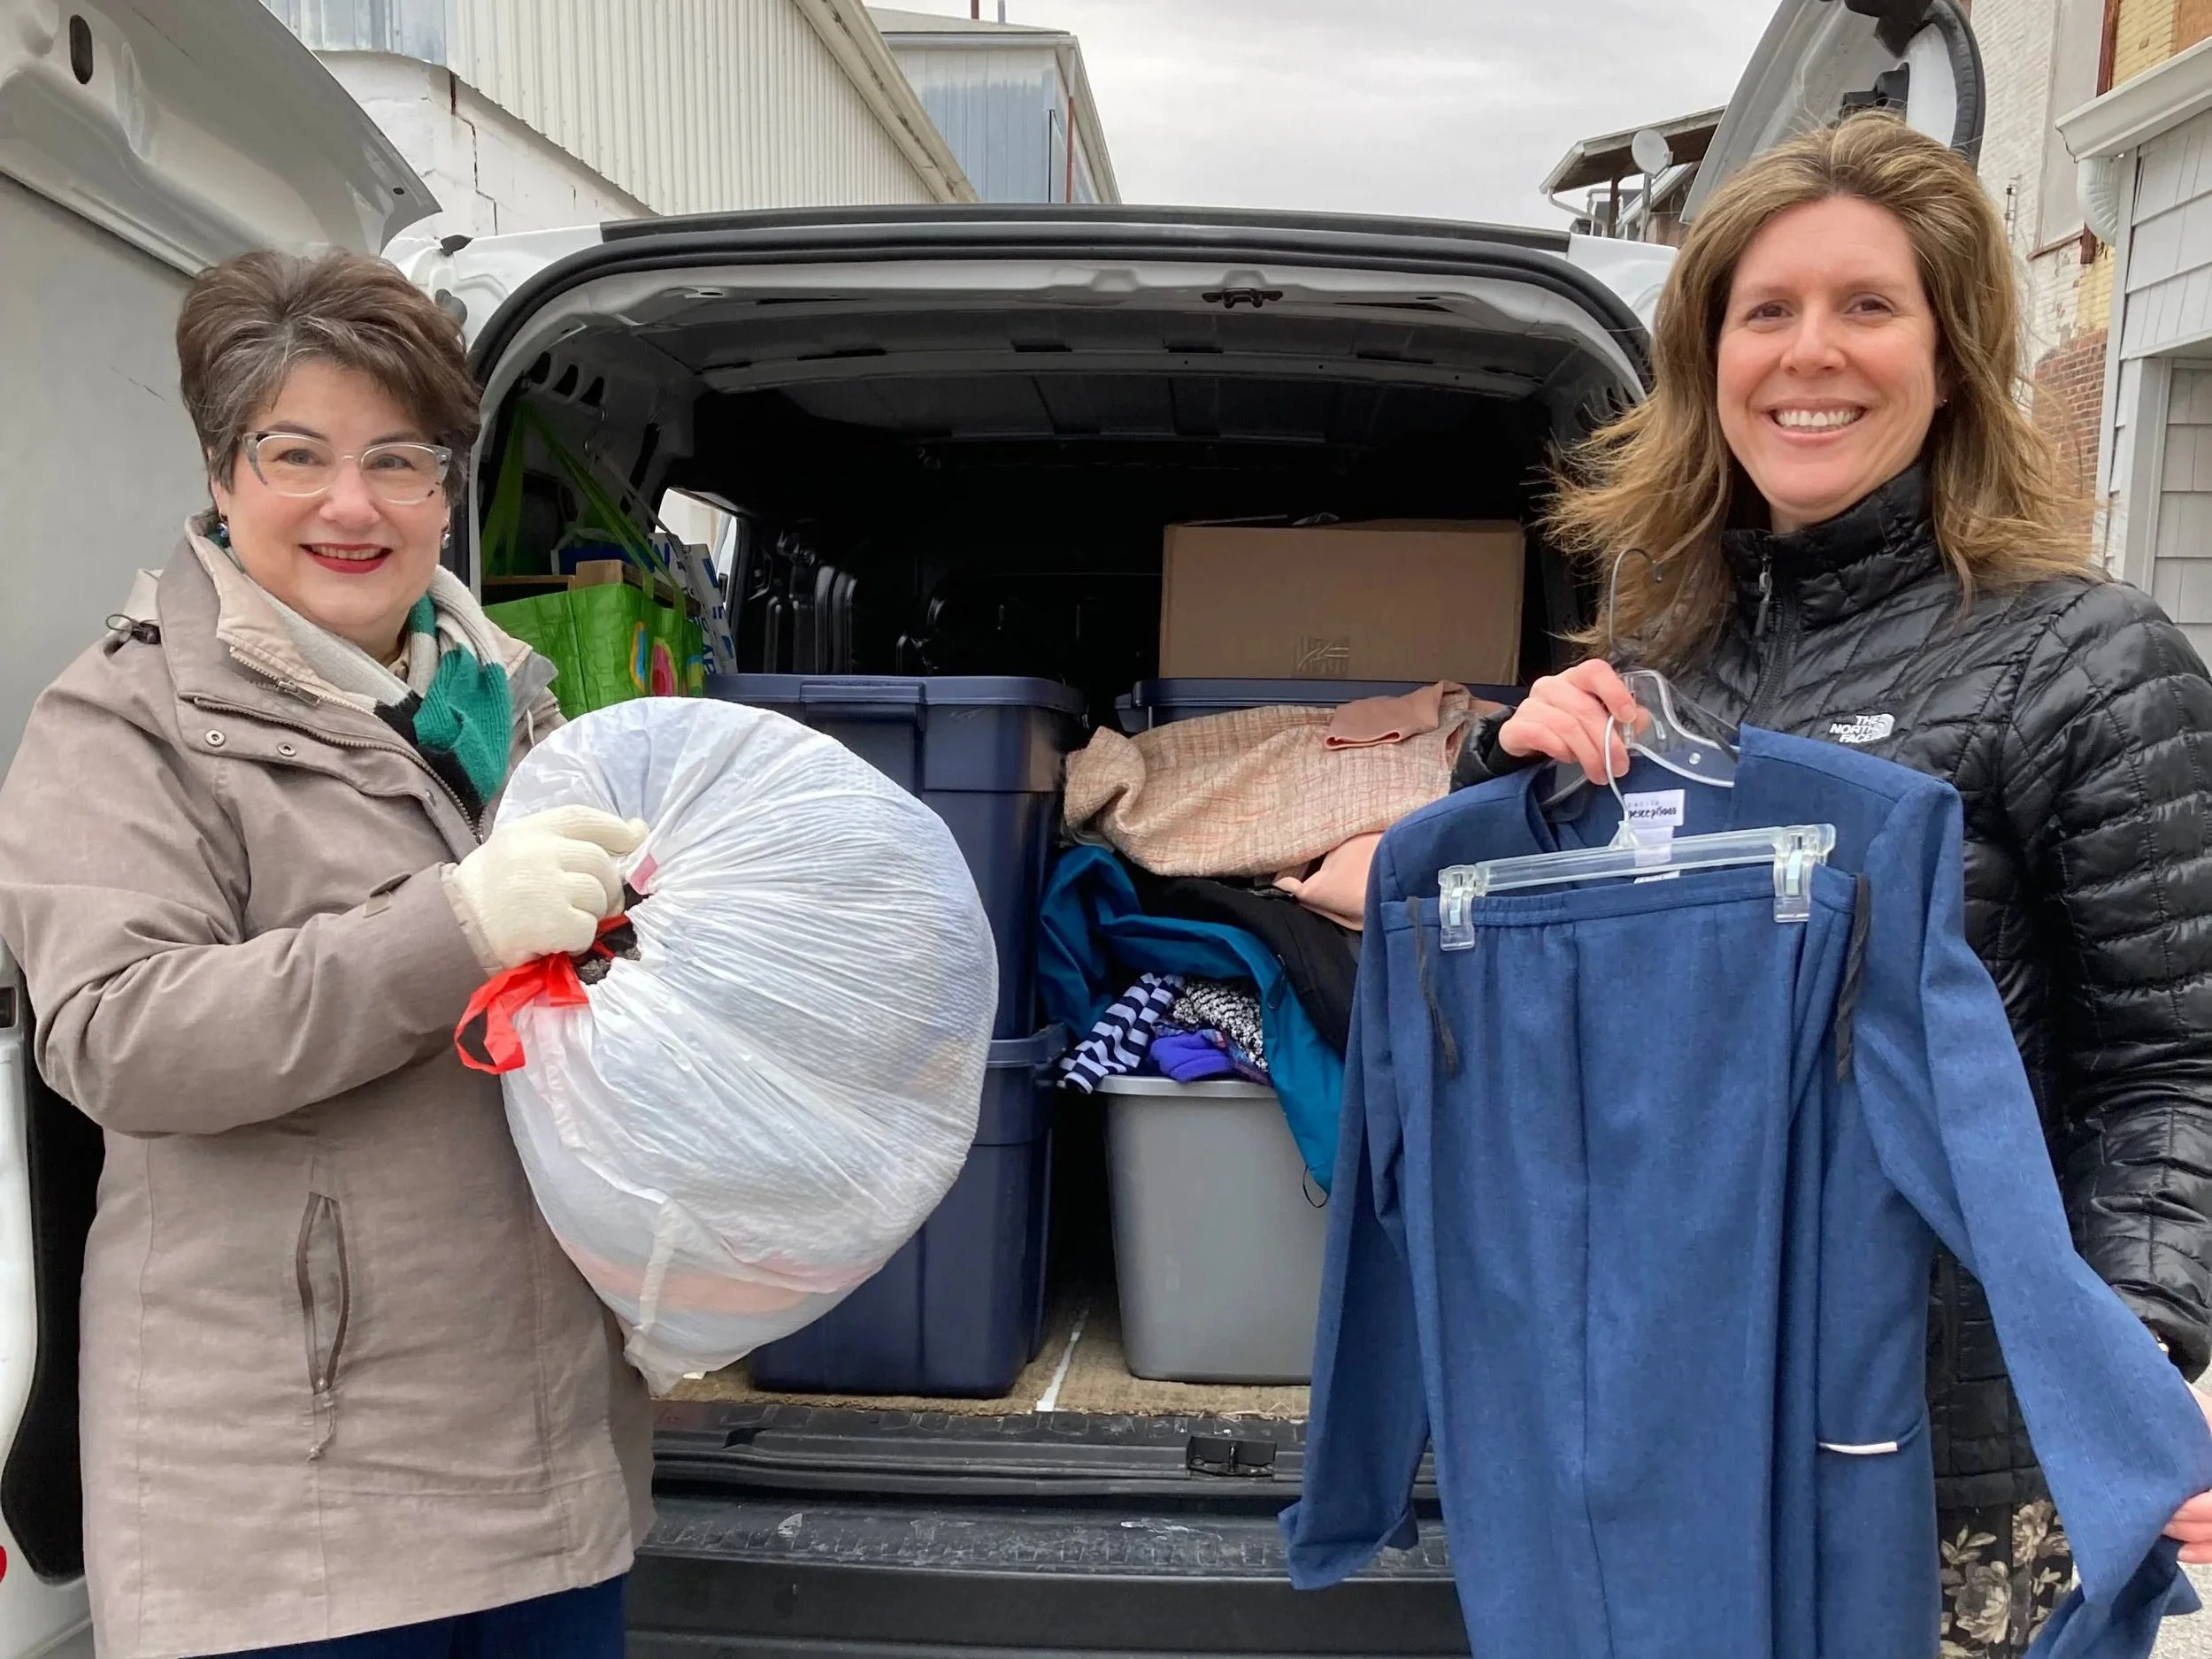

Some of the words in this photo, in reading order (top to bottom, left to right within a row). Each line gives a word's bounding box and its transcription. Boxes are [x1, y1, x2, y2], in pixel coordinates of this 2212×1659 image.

[1855, 715, 1879, 725] THE
[1829, 723, 1875, 733] NORTH
[1839, 733, 1874, 743] FACE
